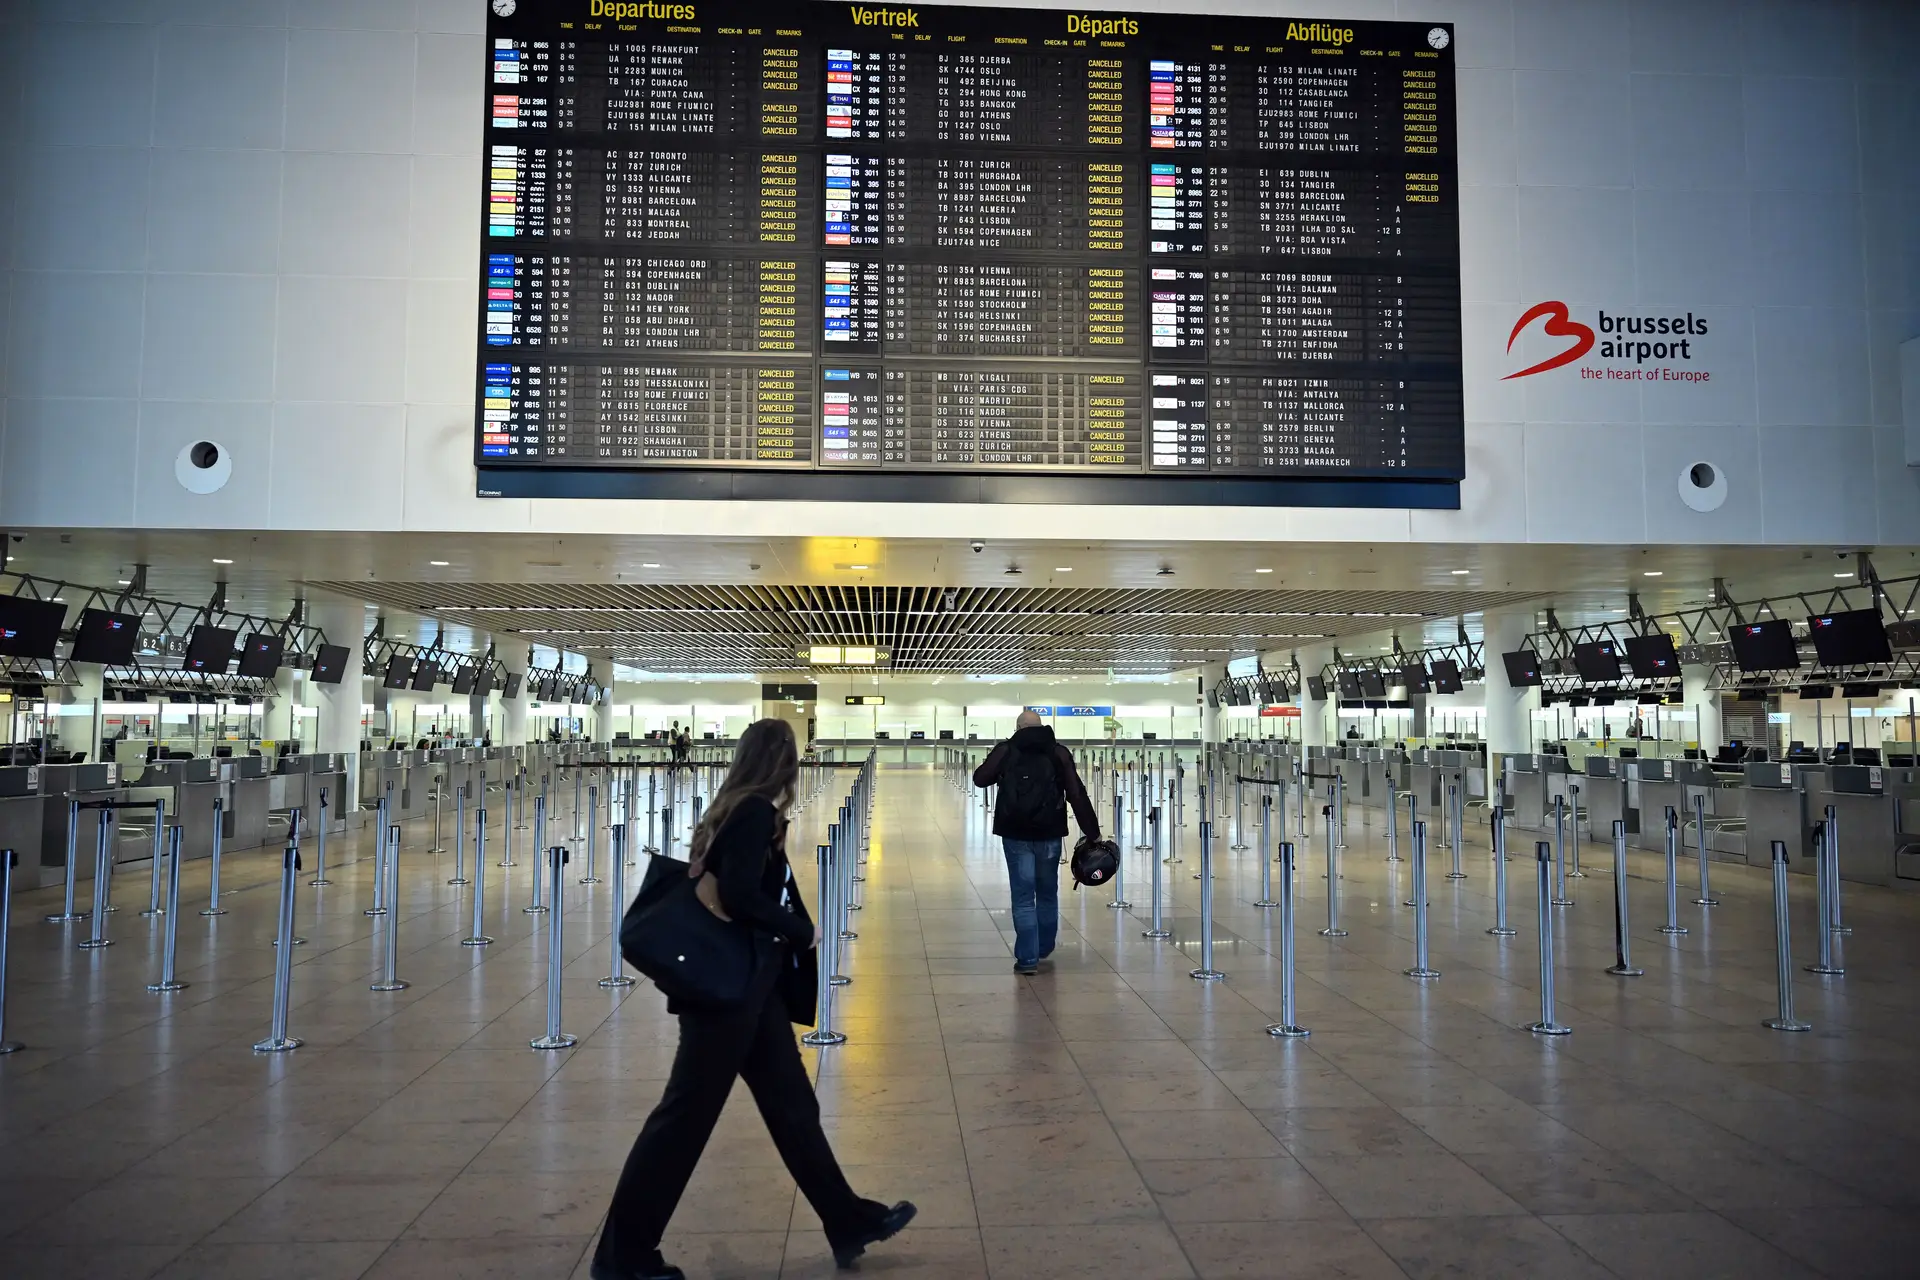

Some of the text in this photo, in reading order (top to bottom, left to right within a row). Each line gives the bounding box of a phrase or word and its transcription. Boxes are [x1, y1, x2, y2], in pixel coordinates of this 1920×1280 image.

[591, 0, 695, 21] Departures
[851, 7, 918, 27] Vertrek
[1068, 15, 1138, 37] Départs
[1286, 23, 1353, 46] Abflüge
[980, 56, 1010, 64] DJERBA
[980, 67, 1000, 75] OSLO
[1328, 68, 1357, 76] LINATE
[652, 79, 797, 90] CURACAO CANCELLED
[1298, 78, 1347, 86] COPENHAGEN
[980, 89, 1000, 97] HONG
[1299, 89, 1348, 97] CASABLANCA
[678, 102, 713, 110] FIUMICI
[1300, 132, 1328, 140] LONDON
[650, 152, 686, 160] TORONTO
[650, 163, 680, 171] ZURICH
[1300, 170, 1329, 178] DUBLIN
[649, 175, 691, 183] ALICANTE
[1300, 192, 1344, 200] BARCELONA
[649, 197, 696, 205] BARCELONA
[1301, 203, 1340, 211] ALICANTE
[1301, 214, 1345, 222] HERAKLION
[648, 220, 690, 228] MONTREAL
[980, 228, 1031, 236] COPENHAGEN
[691, 260, 706, 268] ORD
[648, 271, 700, 279] COPENHAGEN
[1302, 274, 1331, 282] BODRUM
[647, 282, 679, 290] DUBLIN
[980, 278, 1123, 288] BARCELONA CANCELLED
[760, 307, 795, 315] CANCELLED
[980, 312, 1019, 320] HELSINKI
[1599, 310, 1708, 335] brussels
[980, 323, 1031, 331] COPENHAGEN
[1600, 335, 1691, 364] airport
[1581, 367, 1710, 384] the heart of Europe
[759, 381, 794, 389] CANCELLED
[980, 385, 1005, 393] PARIS
[980, 431, 1011, 439] ATHENS
[644, 437, 685, 445] SHANGHAI
[644, 449, 793, 458] WASHINGTON CANCELLED
[980, 453, 1011, 462] LONDON
[1090, 455, 1124, 463] CANCELLED
[1305, 458, 1350, 466] MARRAKECH
